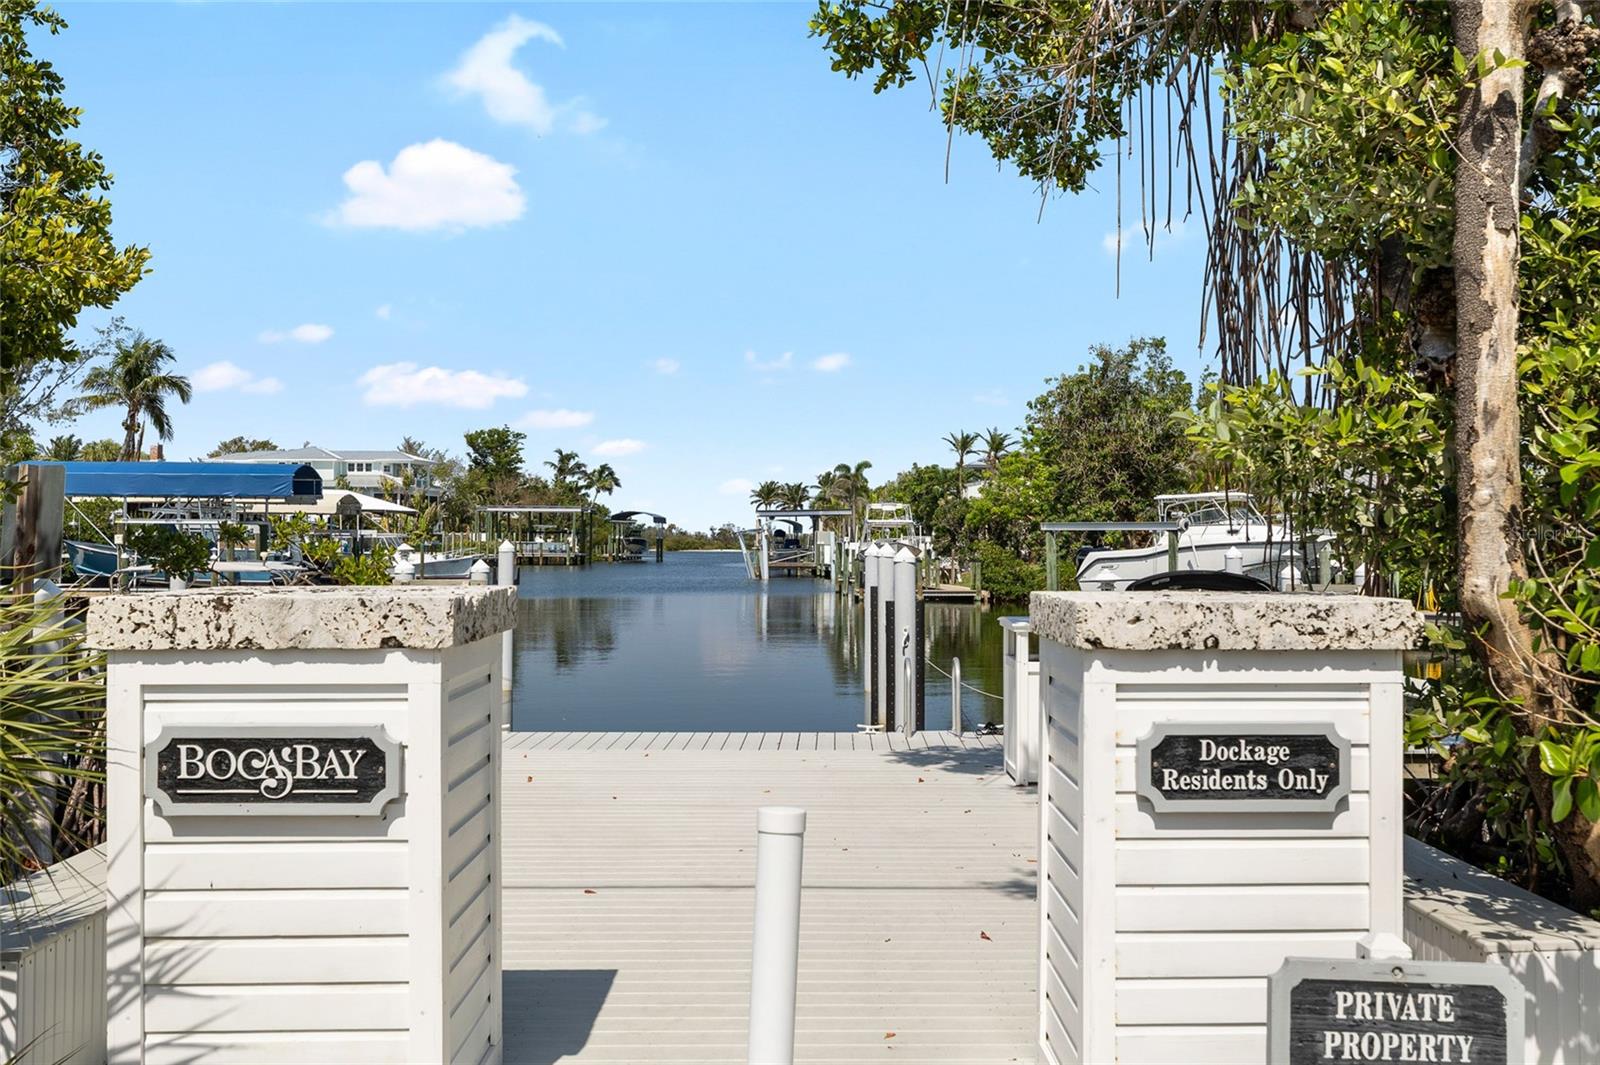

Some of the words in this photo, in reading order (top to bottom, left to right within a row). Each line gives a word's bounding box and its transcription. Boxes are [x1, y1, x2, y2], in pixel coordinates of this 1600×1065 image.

[1200, 739, 1290, 764] Dockage
[1162, 769, 1268, 790] Residents
[1278, 768, 1329, 793] Only
[1336, 991, 1455, 1023] PRIVATE
[1323, 1031, 1474, 1063] PROPERTY
